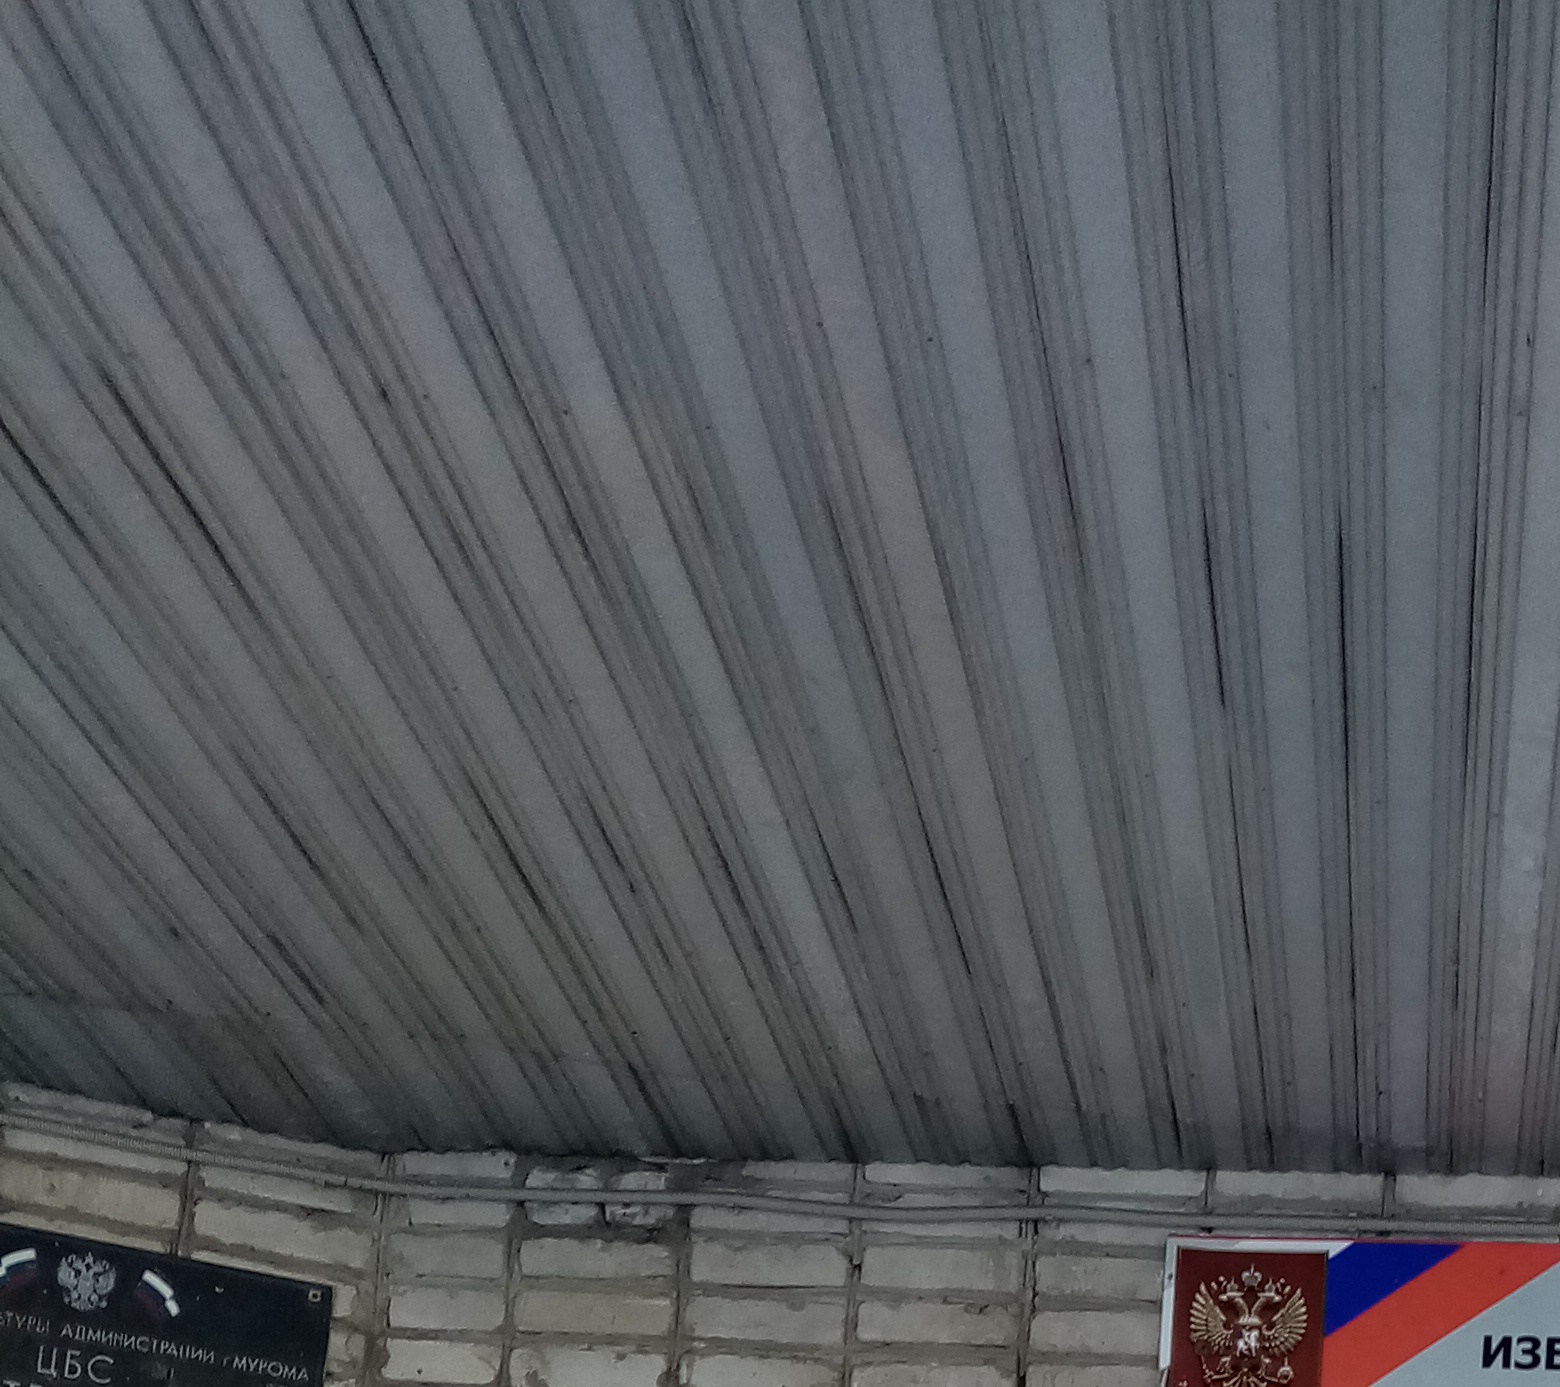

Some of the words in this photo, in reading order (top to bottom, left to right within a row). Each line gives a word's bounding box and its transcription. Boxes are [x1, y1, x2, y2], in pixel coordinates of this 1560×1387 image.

[0, 1310, 50, 1334] ТУРЫ
[60, 1323, 215, 1364] АДМИНИСТРАЦИИ
[233, 1354, 309, 1381] МУРОМА
[37, 1345, 114, 1384] ЦБС
